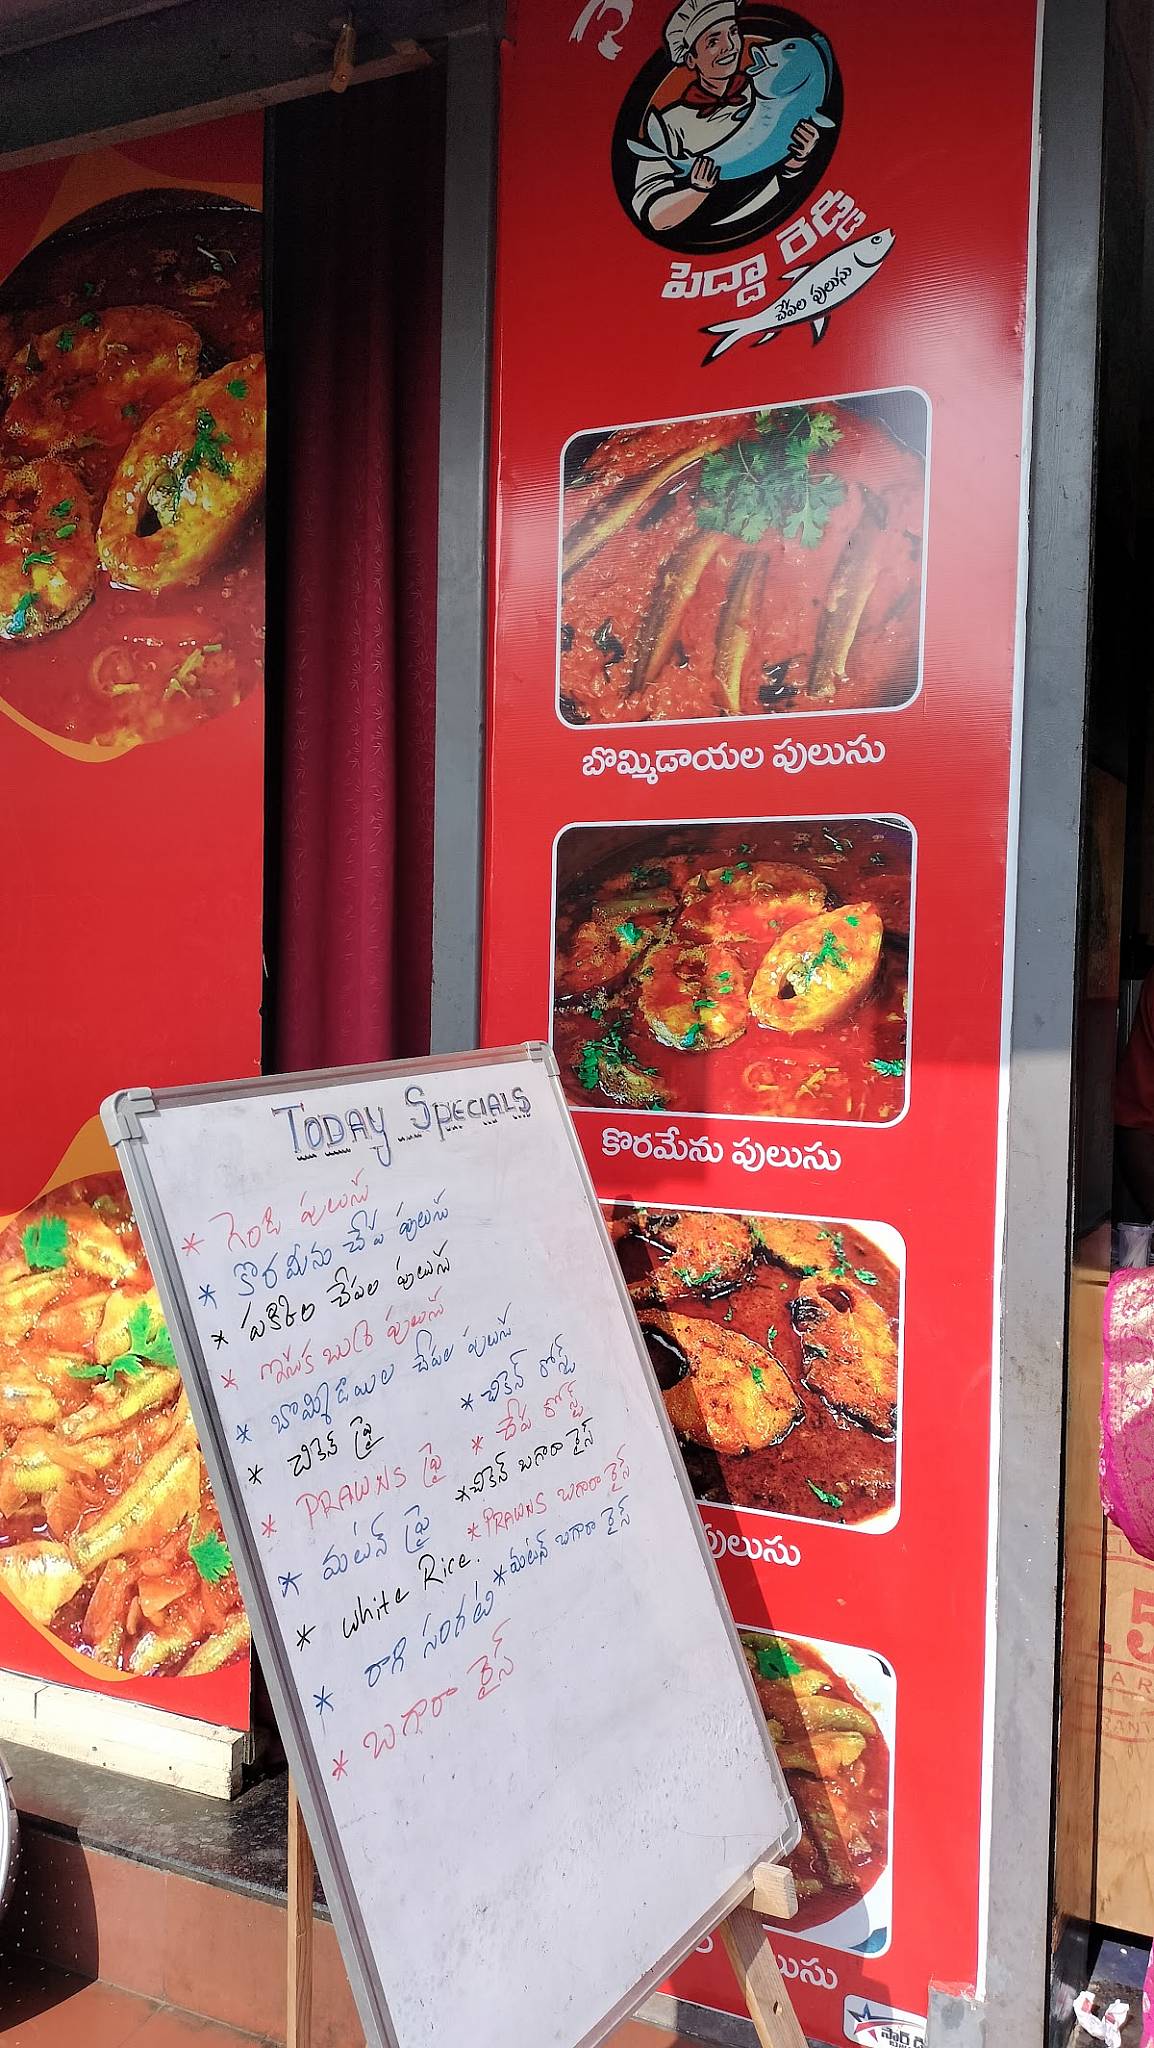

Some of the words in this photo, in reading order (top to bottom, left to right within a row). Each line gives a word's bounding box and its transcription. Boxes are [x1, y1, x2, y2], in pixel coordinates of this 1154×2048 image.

[776, 189, 867, 265] రెడ్డి
[774, 299, 807, 321] చేపల
[810, 265, 852, 305] పులుసు
[581, 742, 764, 785] బొమ్మిడాయల
[772, 733, 887, 775] పులుసు
[601, 1126, 724, 1163] కొరమేను
[731, 1137, 842, 1173] పులుసు
[296, 1465, 408, 1530] PRAWNS
[482, 1491, 548, 1537] PRAWNS
